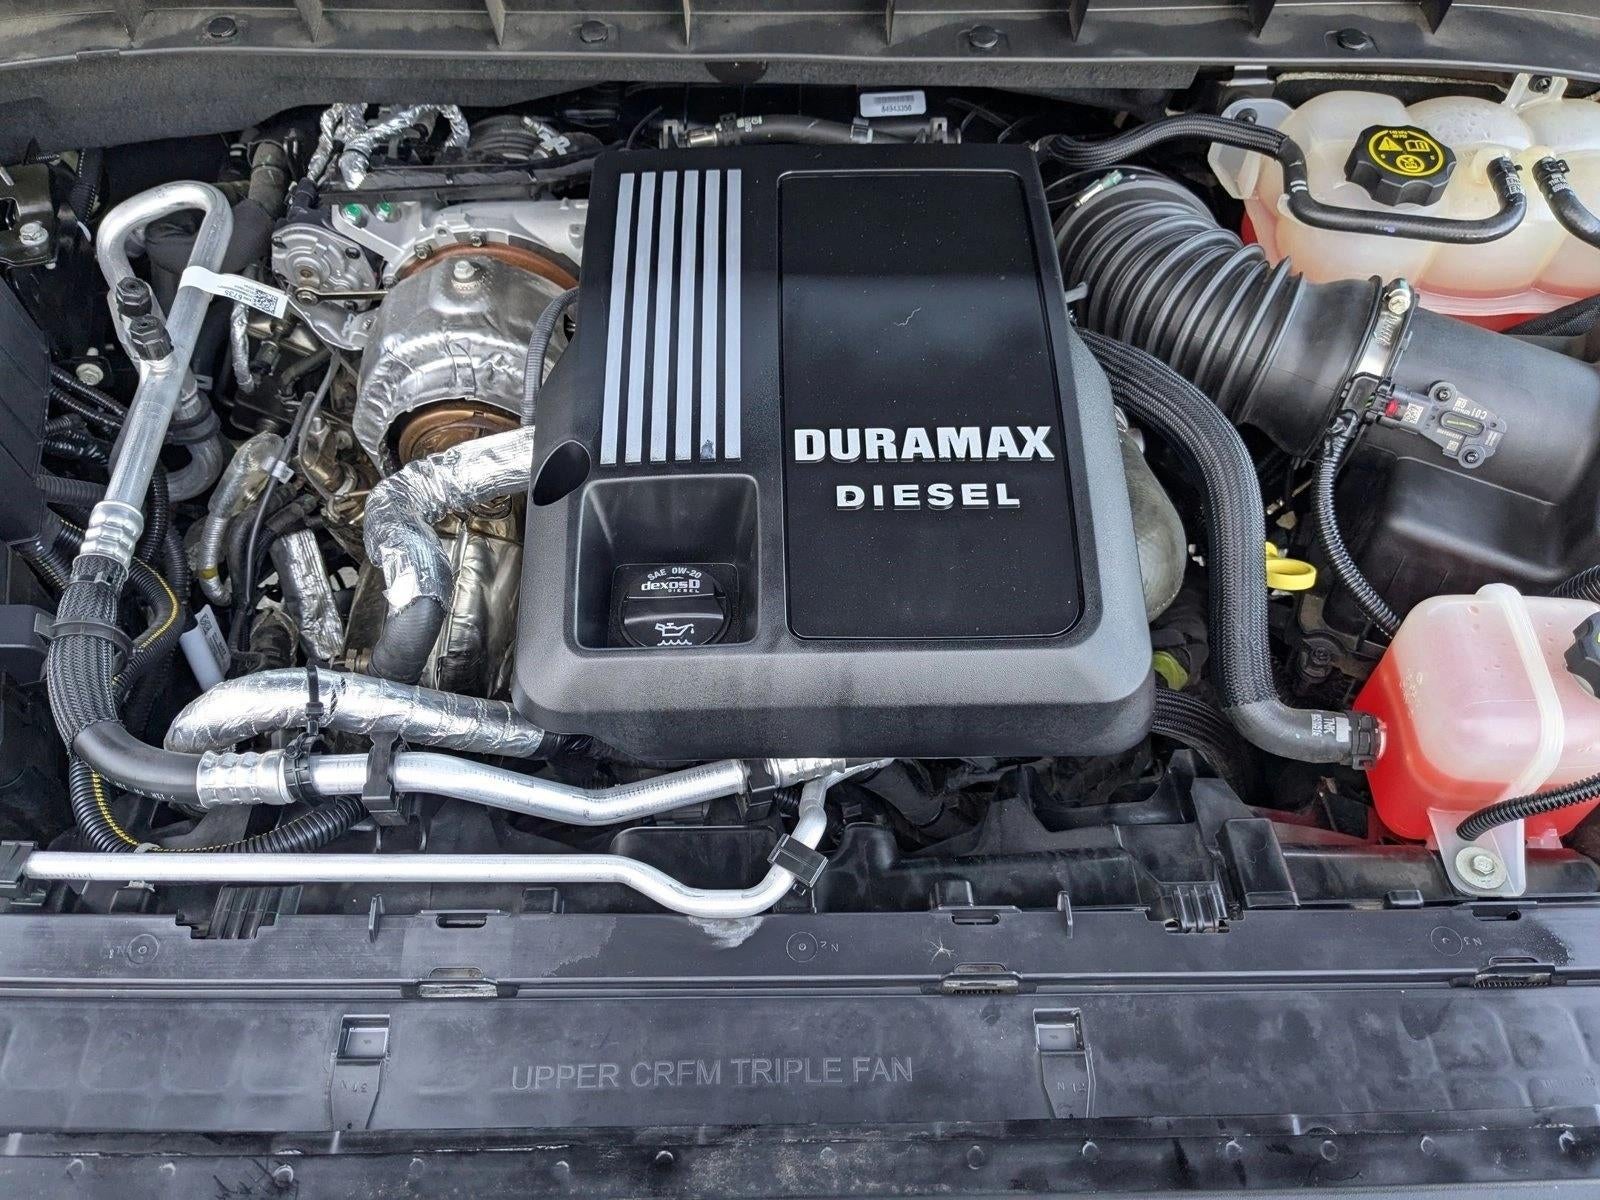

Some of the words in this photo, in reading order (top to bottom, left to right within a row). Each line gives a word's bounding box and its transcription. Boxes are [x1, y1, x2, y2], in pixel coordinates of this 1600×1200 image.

[794, 426, 1055, 462] DURAMAX
[836, 483, 1020, 510] DIESEL
[647, 568, 667, 581] SAE
[671, 567, 702, 579] 0W-20
[511, 1062, 620, 1091] UPPER
[630, 1059, 721, 1088] CRFM
[730, 1057, 843, 1085] TRIPLE
[852, 1056, 913, 1083] FAN
